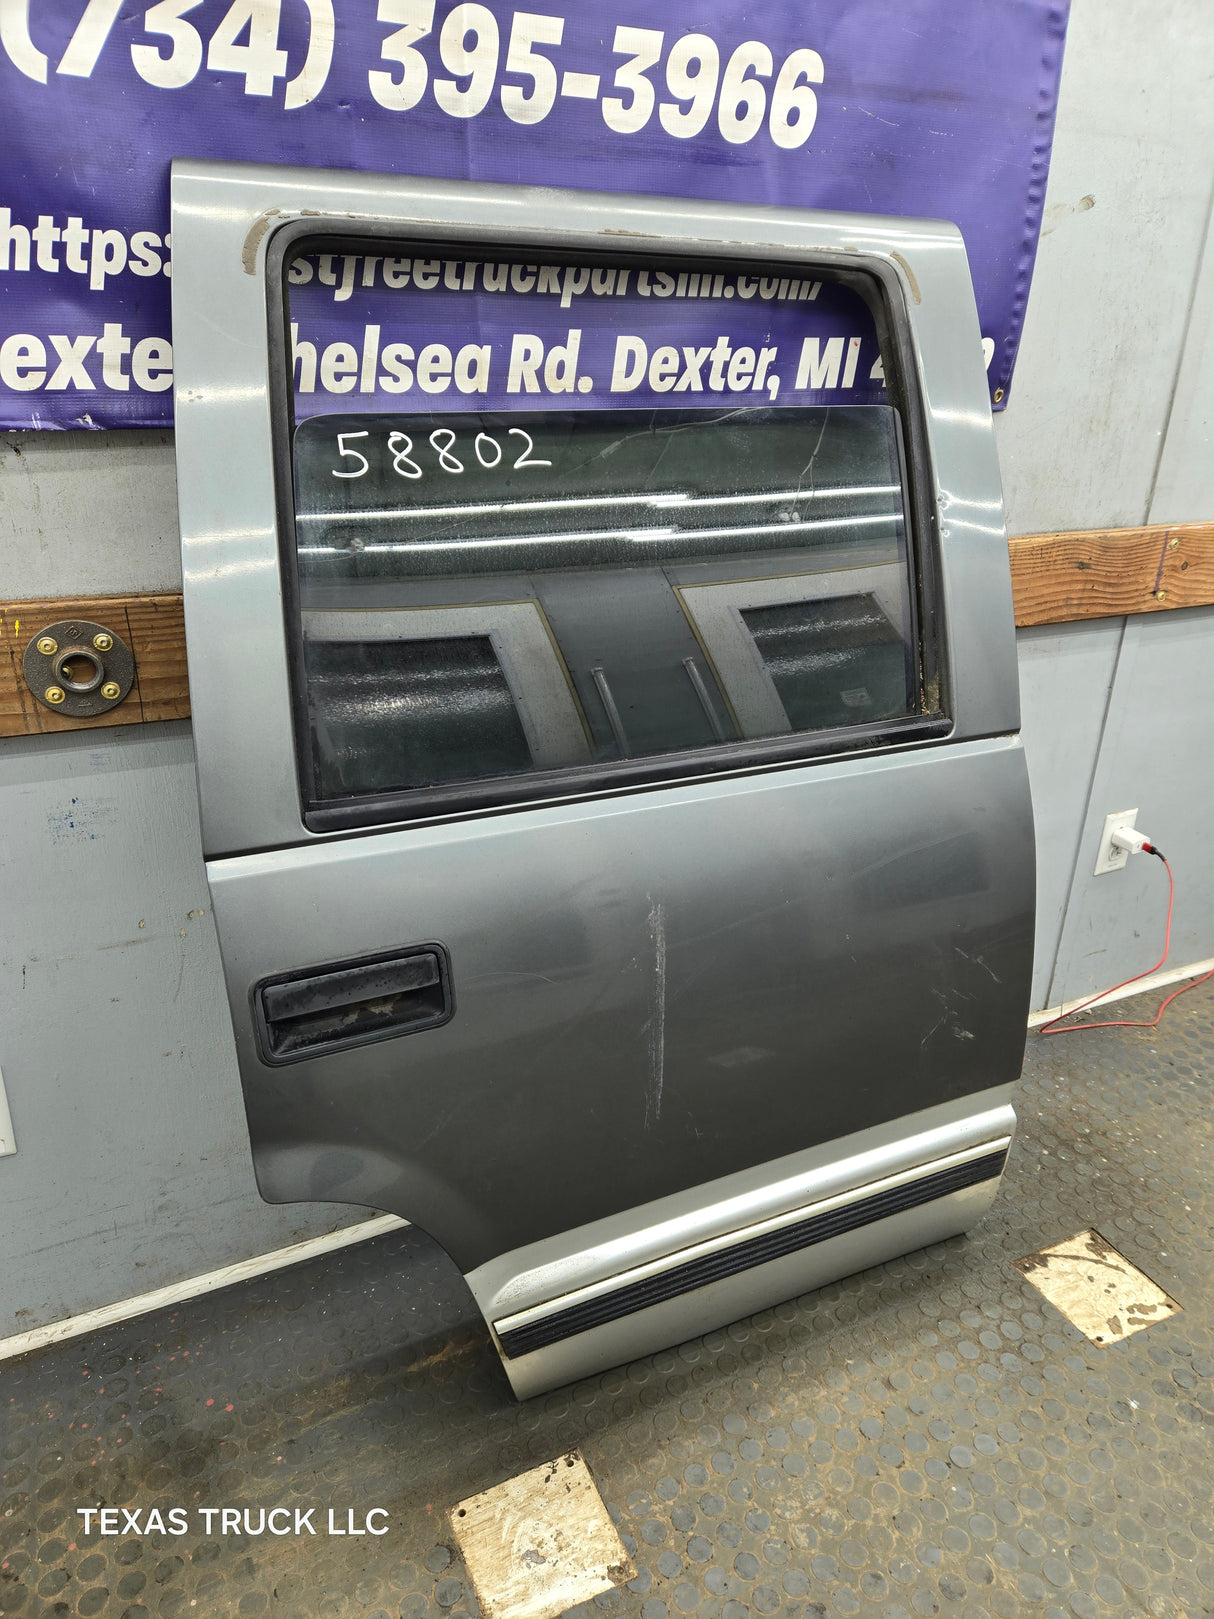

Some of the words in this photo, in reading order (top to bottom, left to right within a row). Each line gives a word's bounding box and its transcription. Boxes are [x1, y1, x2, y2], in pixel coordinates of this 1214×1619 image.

[0, 0, 335, 110] (734)
[368, 0, 824, 149] 395-3966
[506, 329, 593, 393] Rd.
[610, 335, 778, 400] Dexter,
[794, 337, 862, 389] MI
[332, 428, 552, 479] 58802
